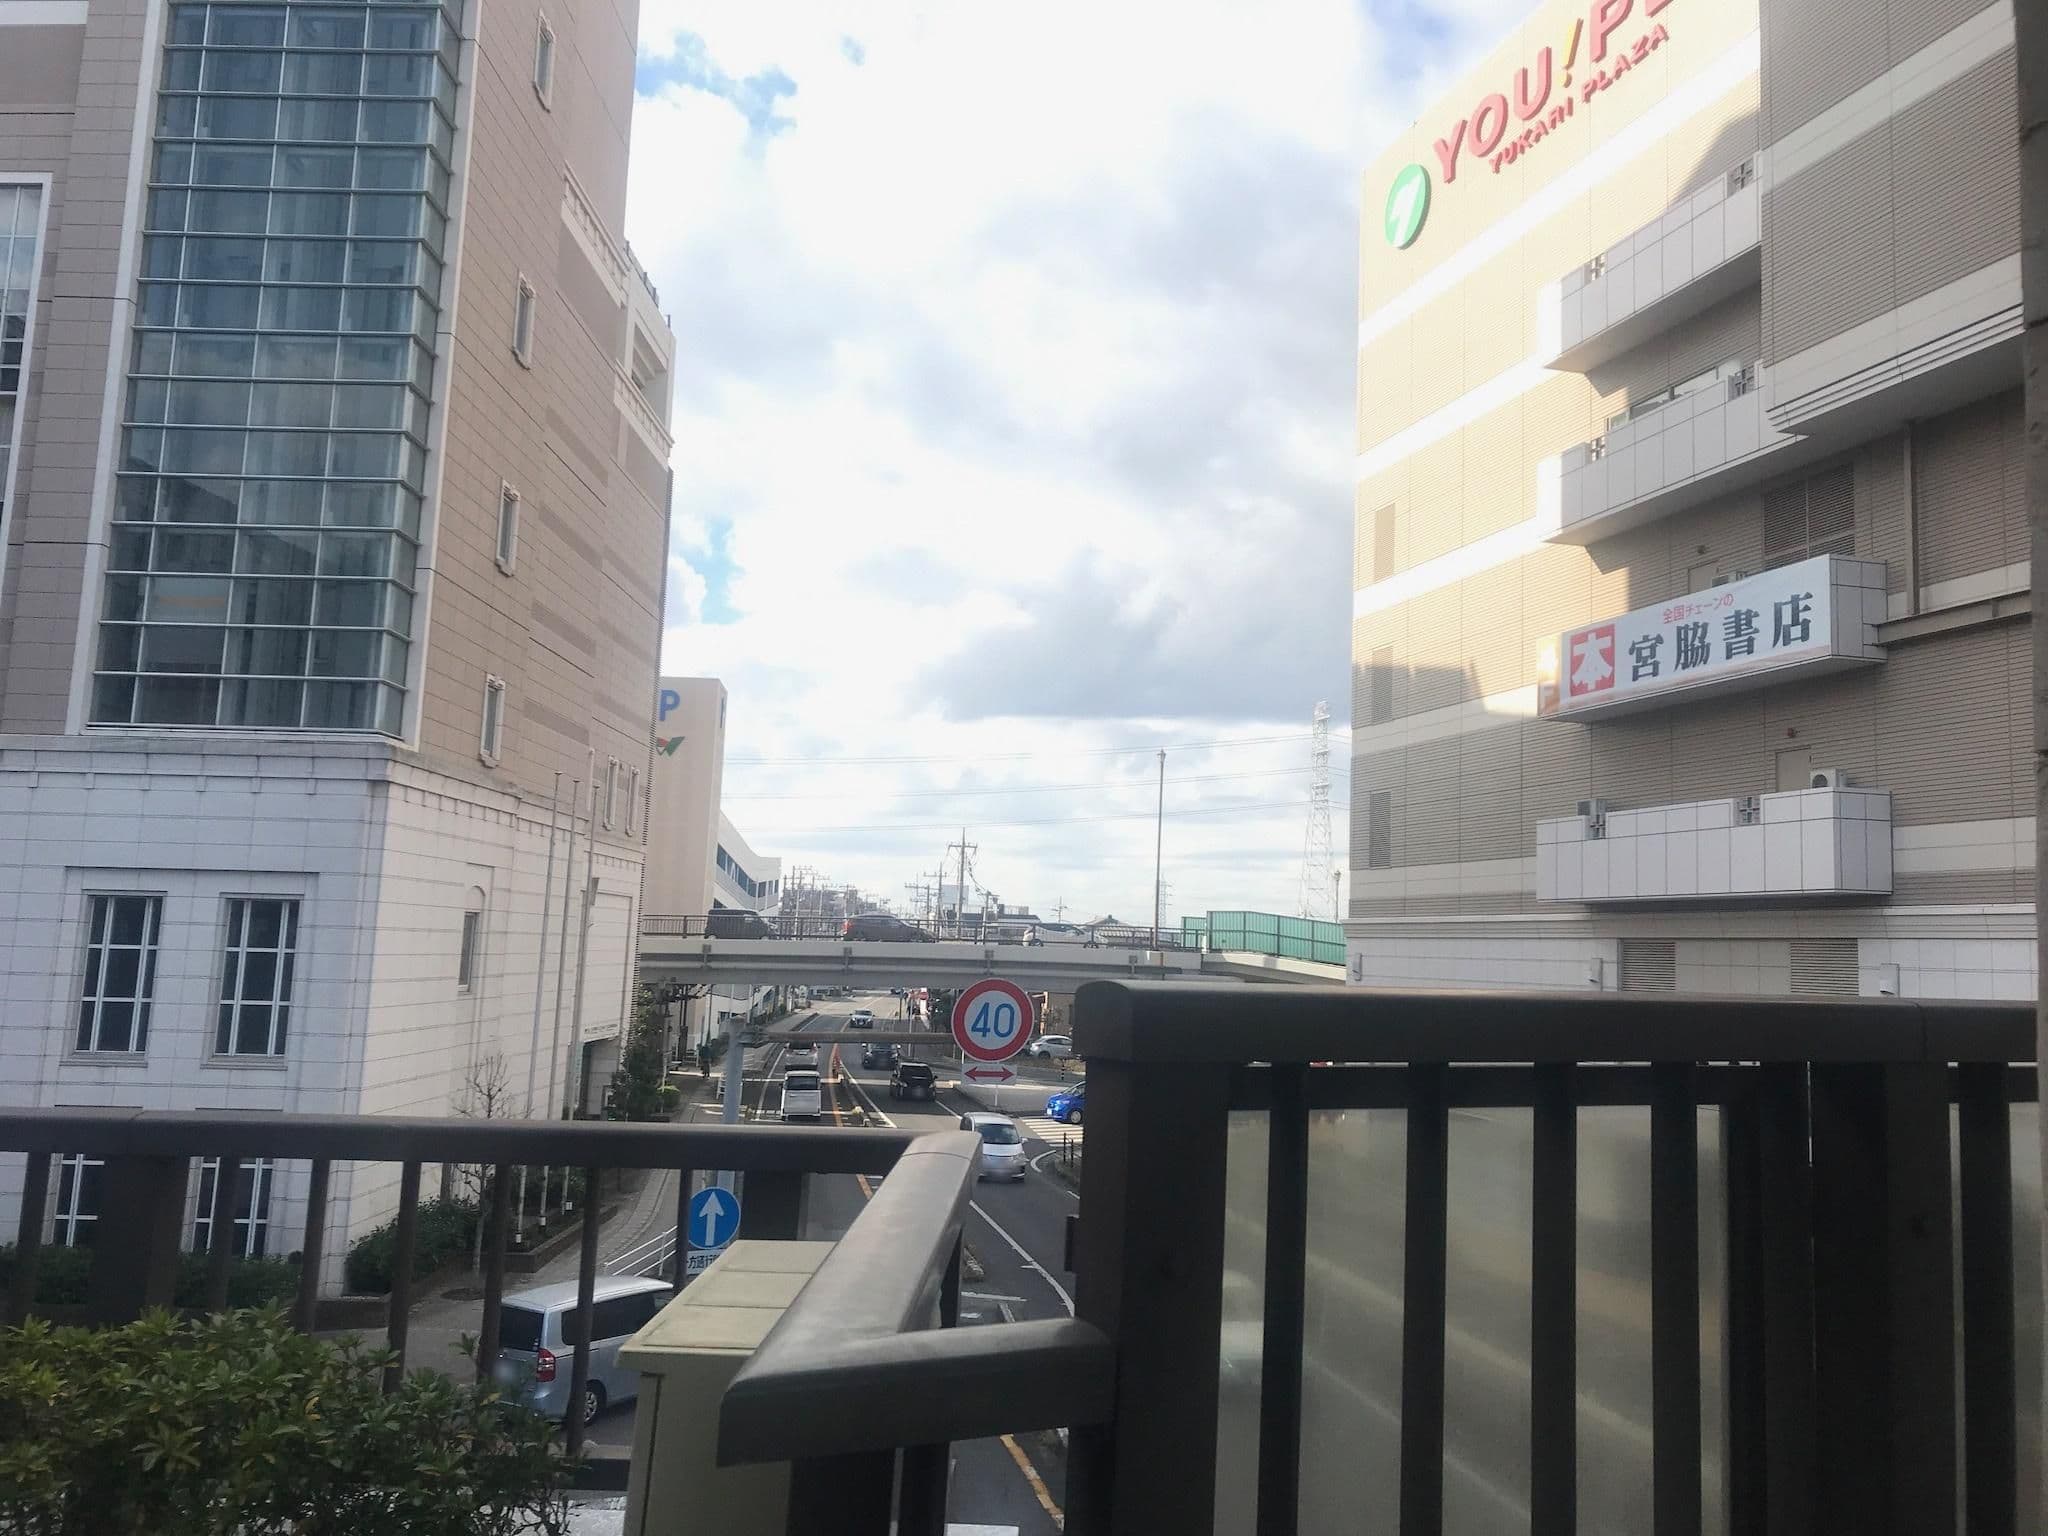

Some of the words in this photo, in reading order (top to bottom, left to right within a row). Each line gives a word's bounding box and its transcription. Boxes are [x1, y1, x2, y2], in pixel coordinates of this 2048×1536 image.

[1433, 0, 1671, 184] YOU!P
[1489, 96, 1574, 174] YUKARI
[1581, 23, 1670, 103] PLAZA
[1628, 592, 1814, 682] 宮脇書店
[1662, 593, 1734, 625] 全国チェーンの
[658, 689, 681, 722] P
[971, 1002, 1015, 1038] 40
